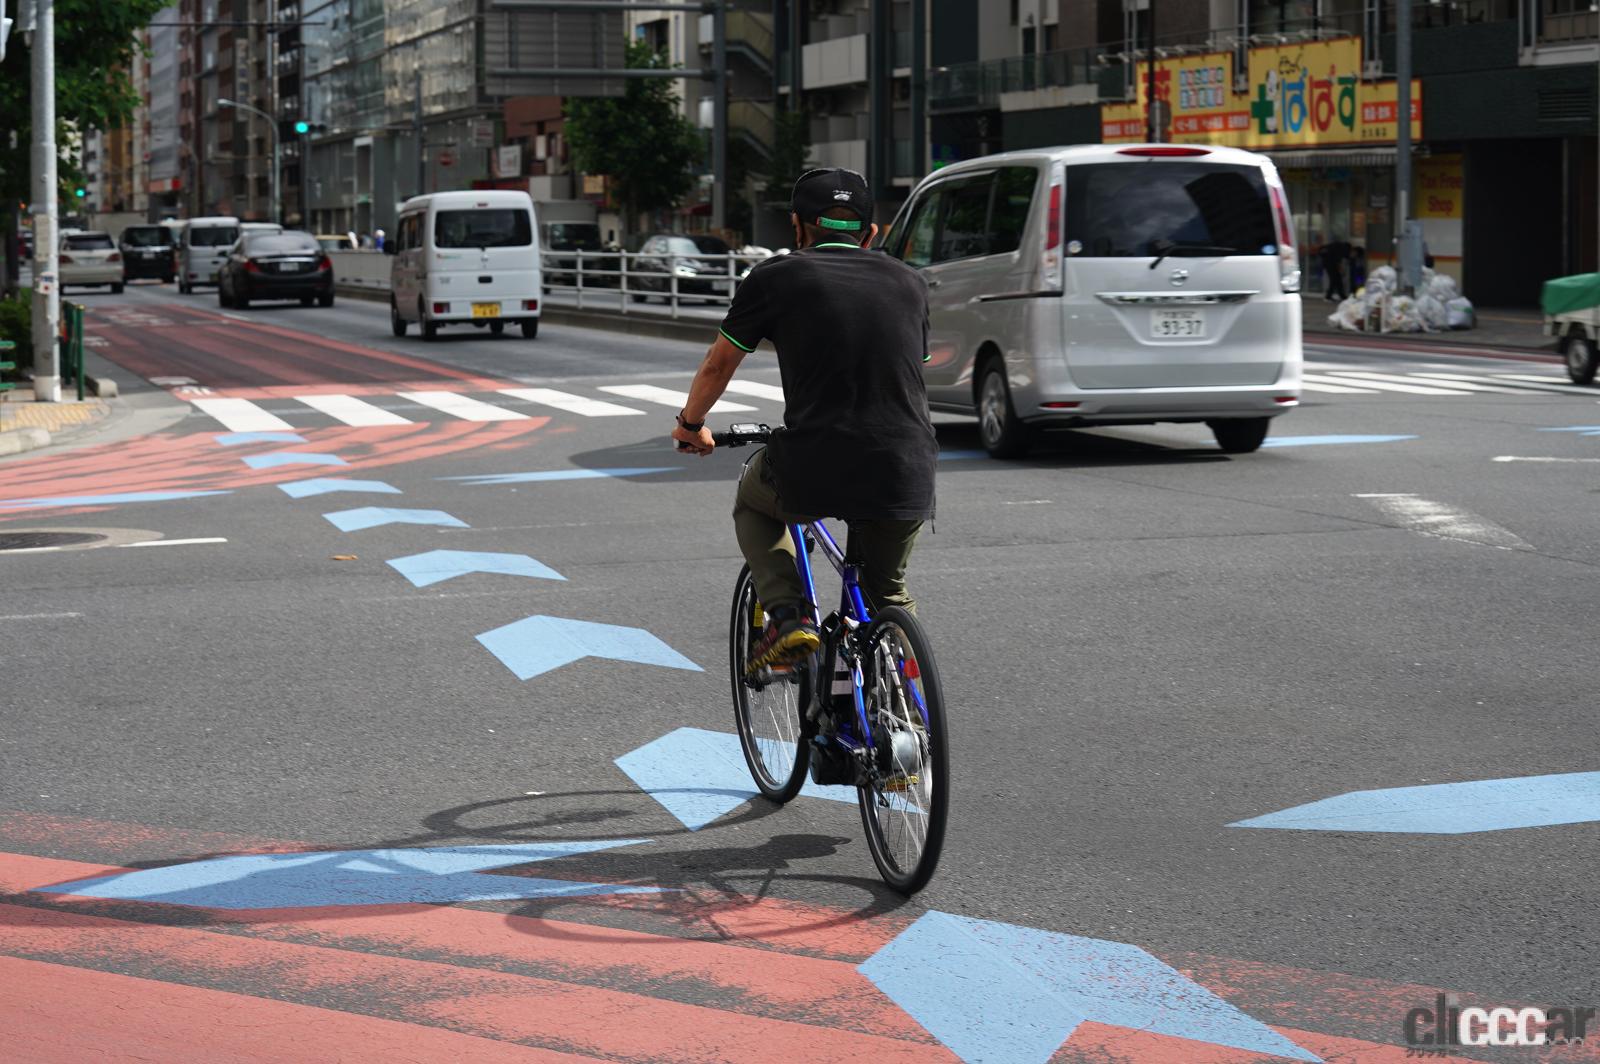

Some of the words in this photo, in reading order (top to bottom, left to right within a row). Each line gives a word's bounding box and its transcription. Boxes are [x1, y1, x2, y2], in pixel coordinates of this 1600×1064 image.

[1281, 64, 1357, 133] ぱぱす
[1428, 195, 1455, 216] Shop
